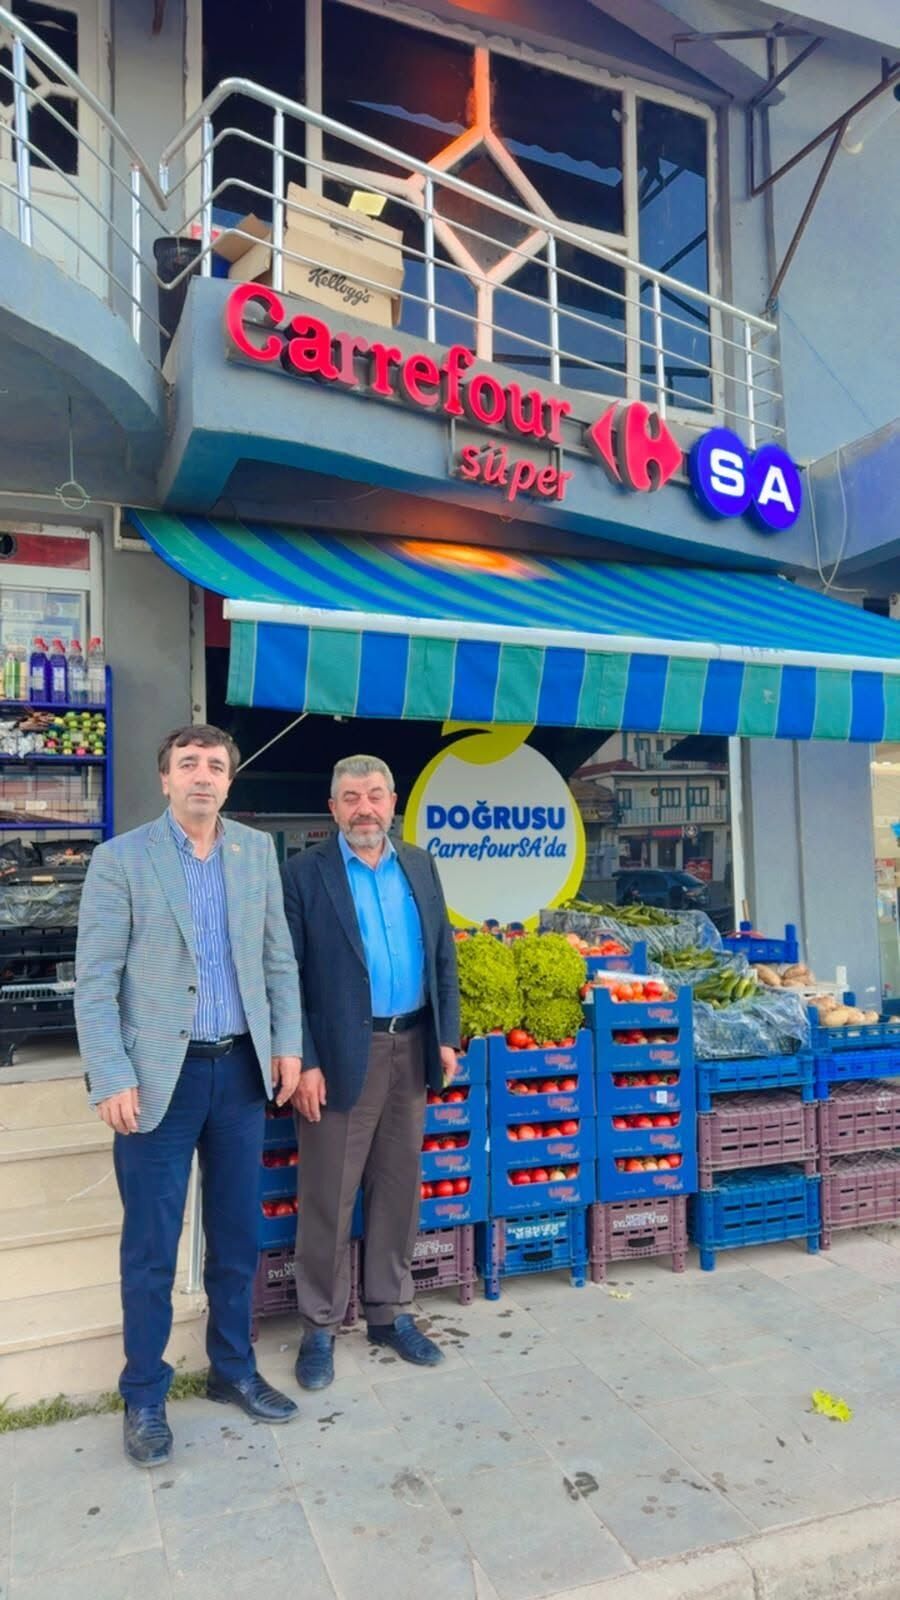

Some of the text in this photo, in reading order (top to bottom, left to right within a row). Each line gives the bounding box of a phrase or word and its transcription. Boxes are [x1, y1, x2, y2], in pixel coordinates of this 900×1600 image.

[308, 266, 373, 306] Kellogg's
[225, 282, 573, 444] Carrefour
[459, 440, 574, 502] süper
[426, 800, 566, 831] DOĞRUSU
[427, 835, 568, 862] CarrefourSA'da
